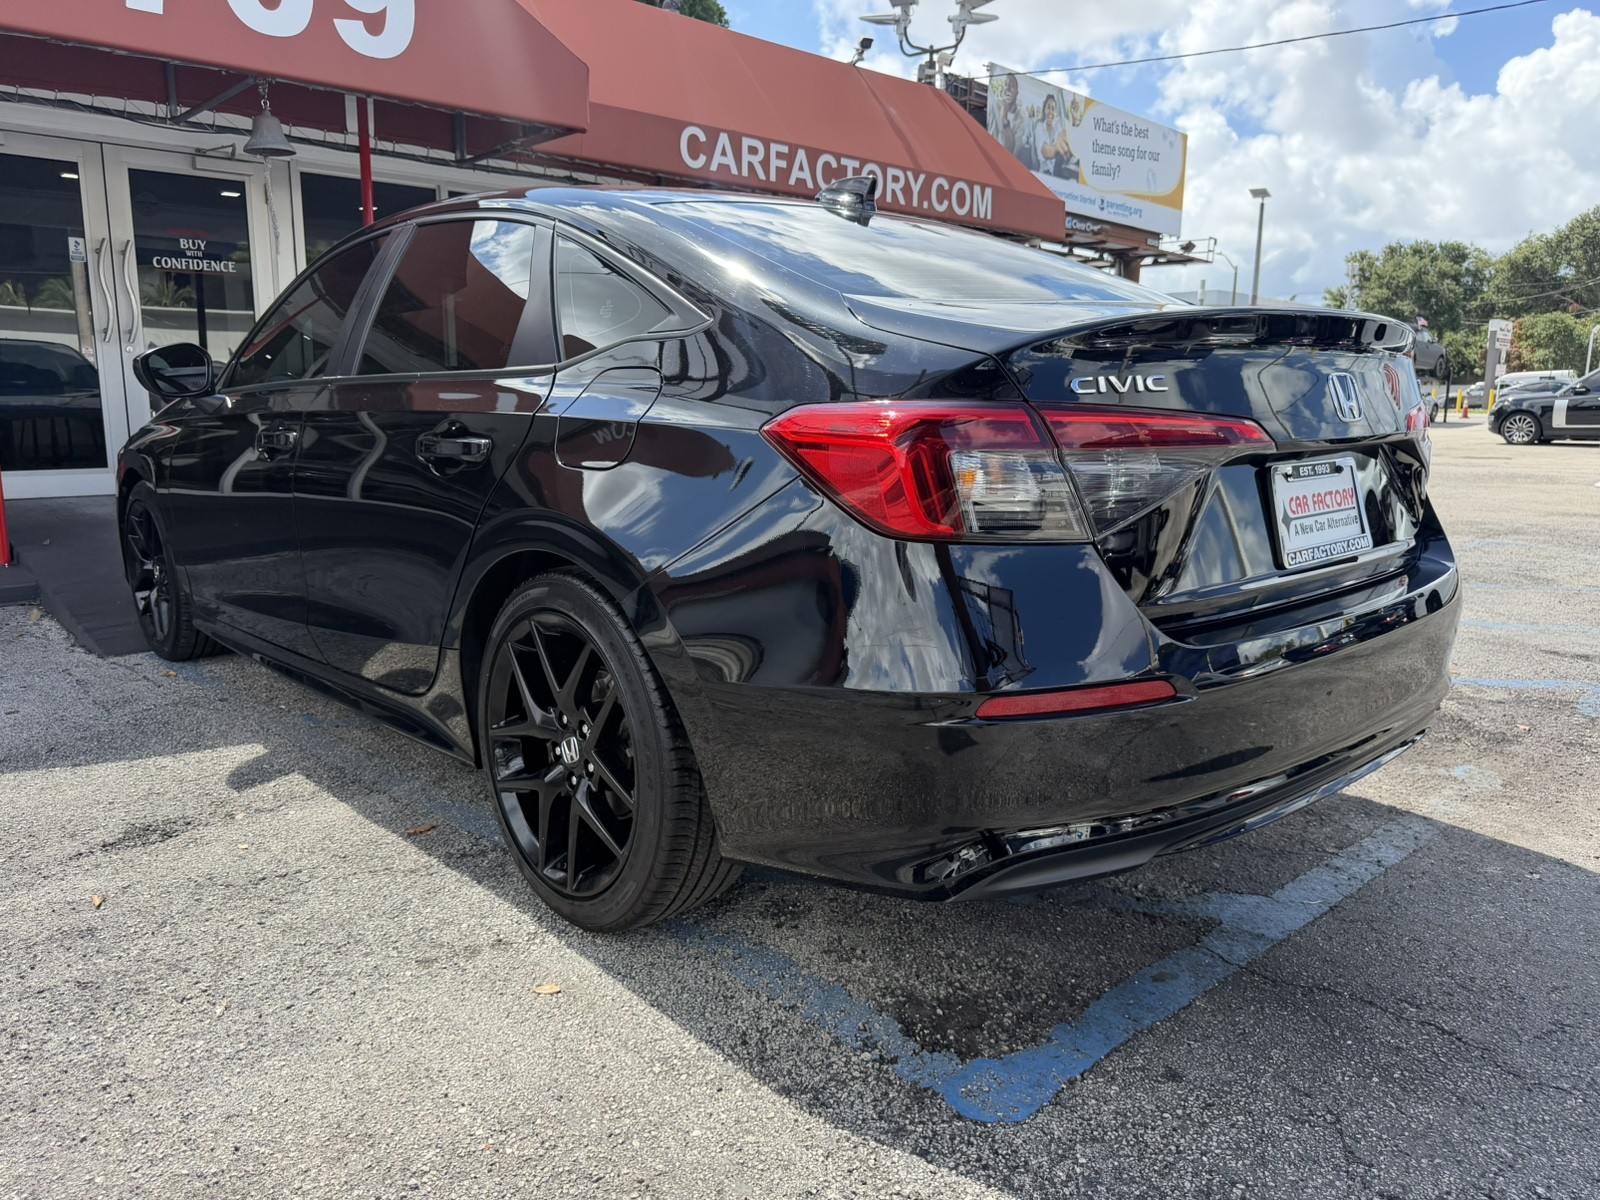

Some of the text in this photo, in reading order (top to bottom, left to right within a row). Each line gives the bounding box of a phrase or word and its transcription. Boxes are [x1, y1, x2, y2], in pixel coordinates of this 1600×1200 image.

[1093, 117, 1149, 139] What's the best
[1092, 138, 1160, 162] theme song for our
[679, 125, 993, 220] CARFACTORY.COM
[1091, 160, 1121, 181] family?
[1106, 199, 1143, 219] parenting.org
[179, 238, 206, 251] BUY
[185, 250, 203, 258] WITH
[152, 256, 237, 273] CONFIDENCE
[1070, 374, 1169, 394] CIVIC
[1299, 463, 1330, 476] EST. 1993
[1289, 487, 1354, 515] CAR FACTORY
[1294, 513, 1359, 537] A New Car Alternative
[1288, 536, 1370, 565] CARFACTORY.COM
